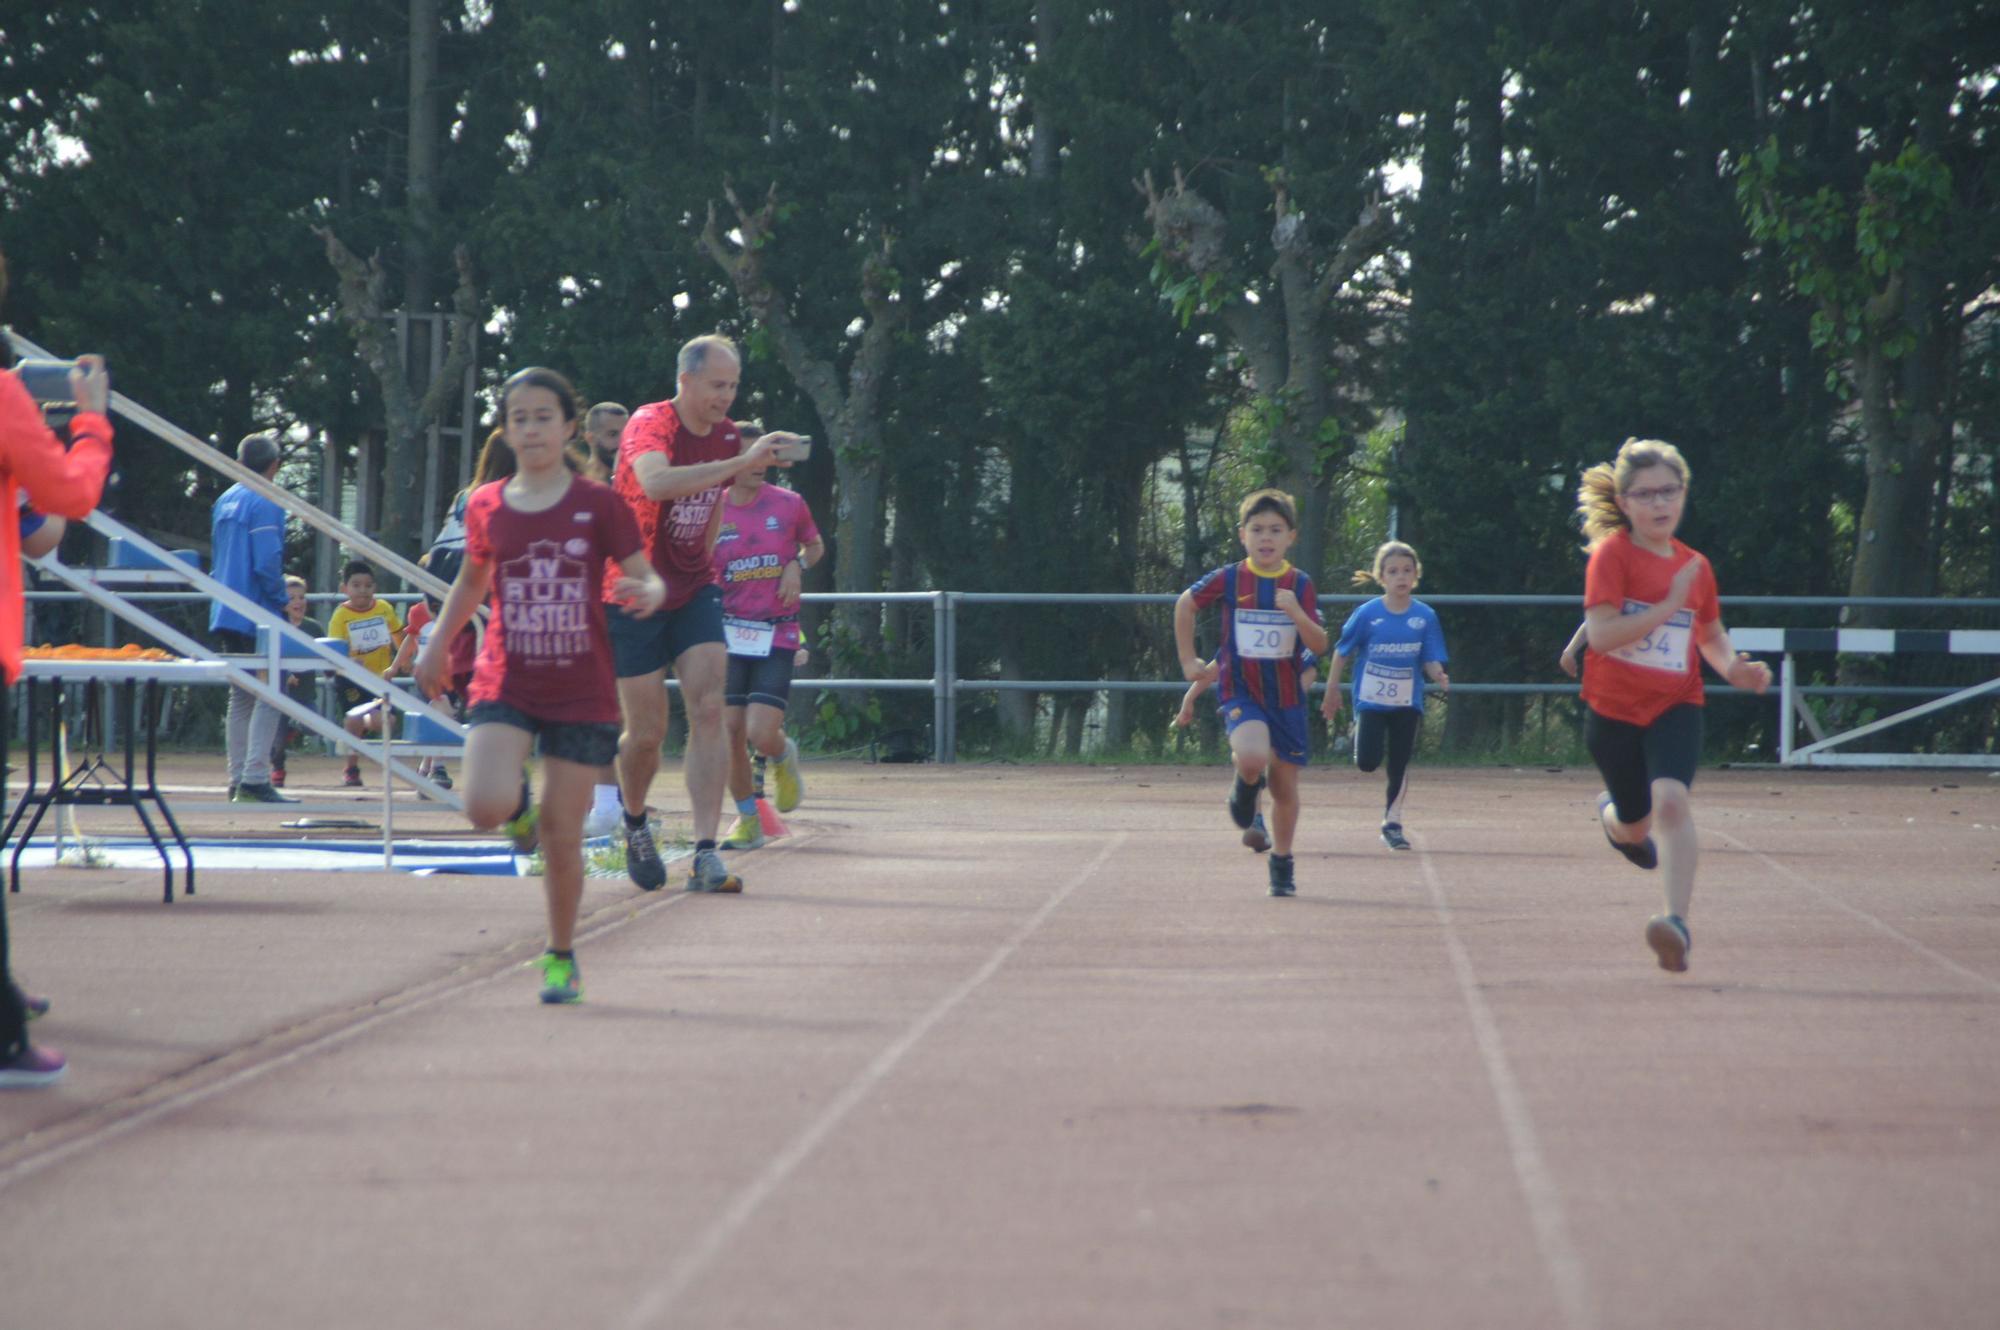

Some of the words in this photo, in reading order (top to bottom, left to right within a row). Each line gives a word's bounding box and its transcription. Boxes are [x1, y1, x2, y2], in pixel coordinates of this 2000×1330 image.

[529, 558, 561, 578] XV
[727, 556, 760, 571] ROAD
[760, 553, 779, 567] TO
[506, 582, 582, 600] RUN
[503, 602, 588, 632] CASTELL
[362, 628, 379, 641] 40
[1253, 629, 1282, 648] 20
[1376, 681, 1399, 698] 28
